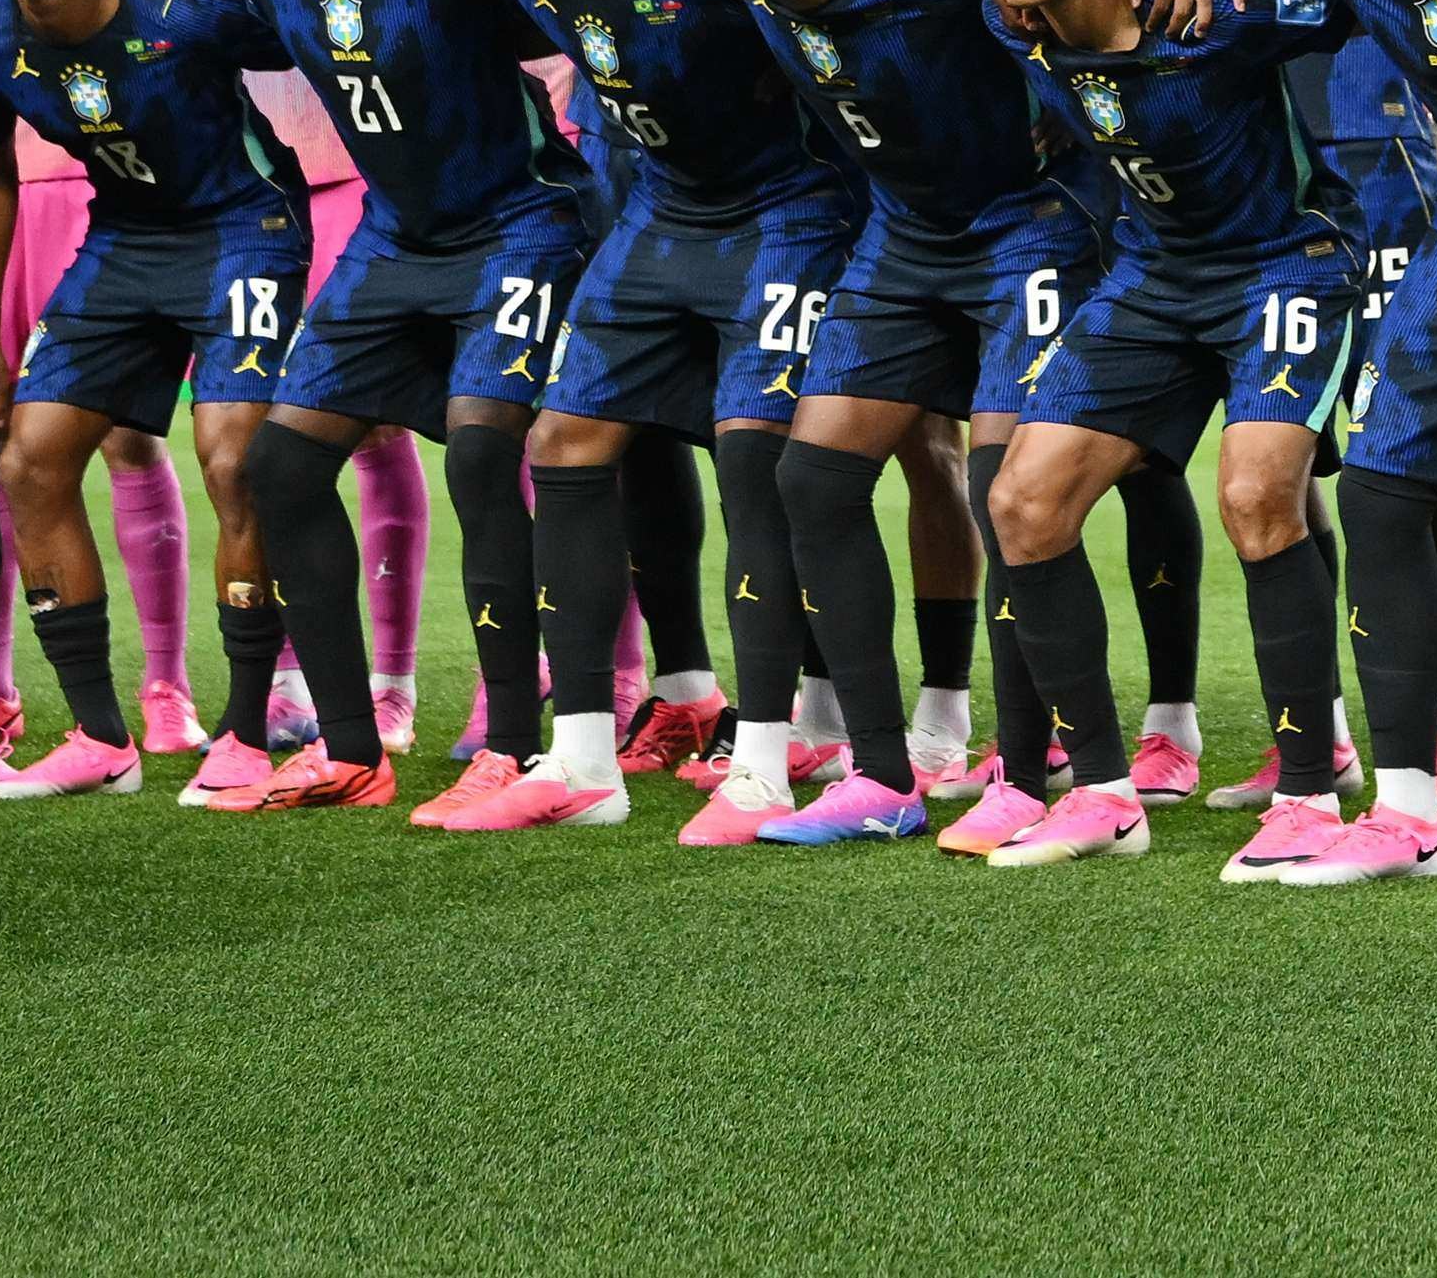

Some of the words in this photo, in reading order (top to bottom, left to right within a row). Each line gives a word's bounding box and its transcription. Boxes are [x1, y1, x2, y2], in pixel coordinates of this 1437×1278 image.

[331, 50, 372, 62] BRASIL
[337, 75, 402, 133] 21
[592, 73, 633, 88] BRASIL
[80, 122, 124, 133] BRASIL
[838, 101, 881, 148] 6
[95, 141, 156, 184] 18
[1110, 155, 1174, 203] 16
[228, 278, 277, 341] 18
[494, 277, 553, 344] 21
[1025, 268, 1060, 337] 6
[1262, 292, 1317, 355] 16
